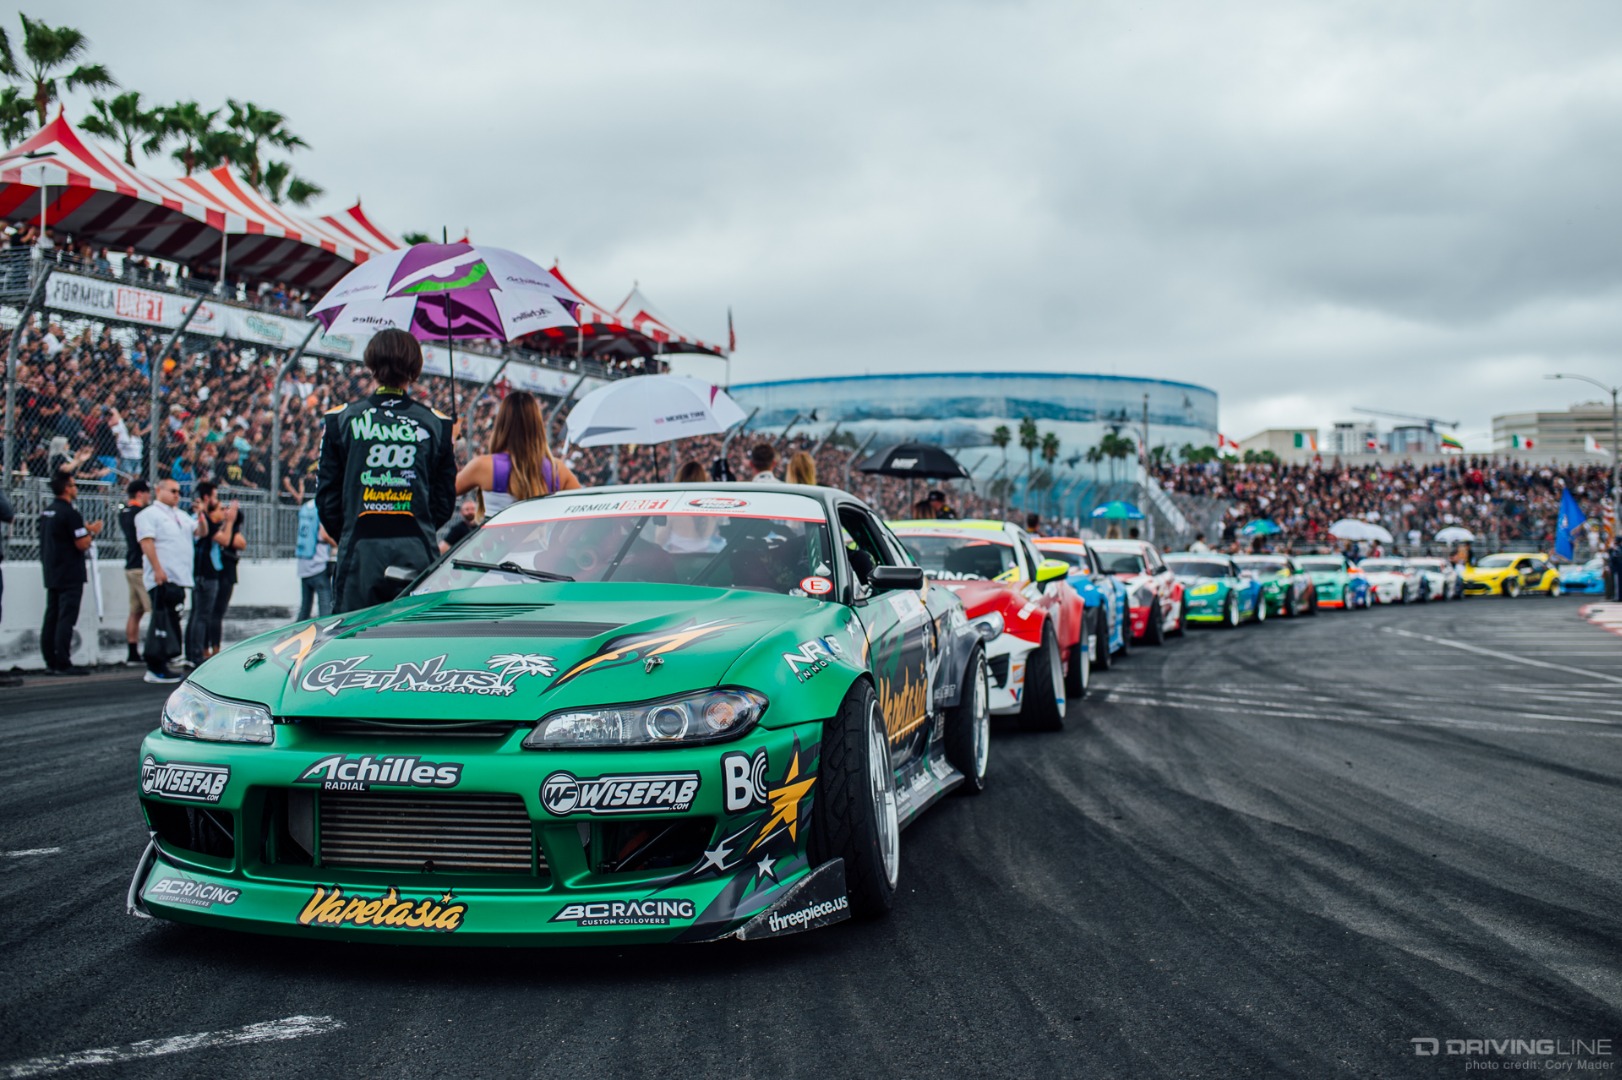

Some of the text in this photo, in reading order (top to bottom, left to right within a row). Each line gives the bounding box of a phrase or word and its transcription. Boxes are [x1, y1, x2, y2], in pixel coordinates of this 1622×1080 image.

[54, 281, 116, 309] FORMULA
[366, 444, 416, 468] 808
[564, 502, 620, 513] FORMULA
[619, 499, 669, 511] DRIFT
[810, 579, 822, 591] E
[392, 683, 515, 697] LABORATORY
[155, 768, 228, 795] WISEFAB
[302, 756, 459, 785] Achilles
[324, 781, 365, 791] RADIAL
[579, 780, 699, 808] WISEFAB
[299, 886, 464, 930] Vapetasia
[768, 895, 849, 932] threepiece.us
